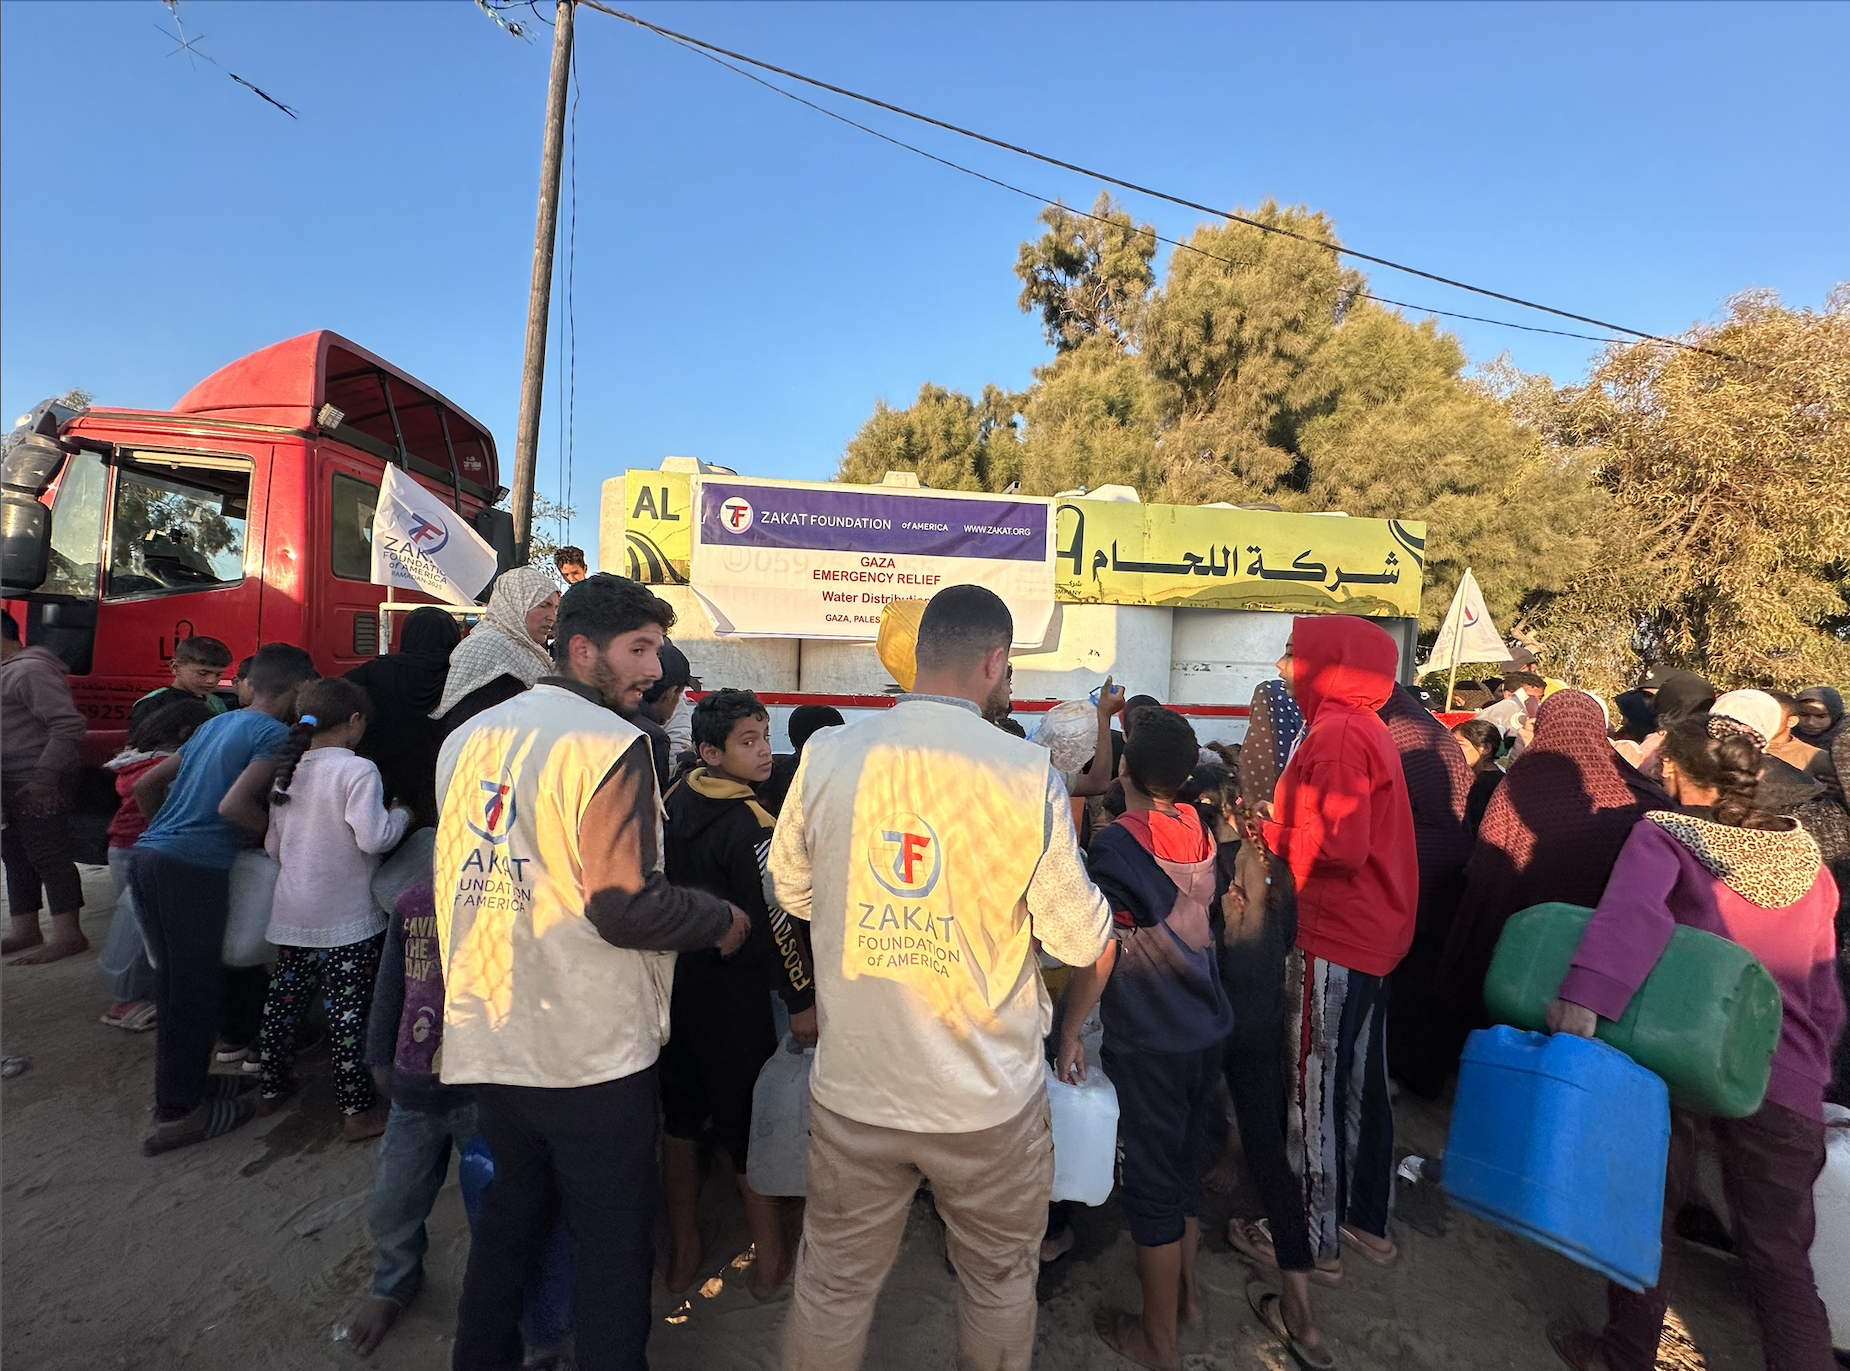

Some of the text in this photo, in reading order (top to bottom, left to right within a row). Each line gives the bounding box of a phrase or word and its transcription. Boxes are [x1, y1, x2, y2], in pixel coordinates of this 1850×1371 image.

[632, 486, 679, 521] AL
[760, 511, 808, 526] ZAKAT
[810, 515, 892, 530] FOUNDATION
[911, 522, 949, 532] AMERICA
[963, 524, 1031, 537] WWW.ZAKAT.ORG
[384, 535, 433, 563] ZAK
[860, 556, 896, 569] GAZA
[1092, 539, 1399, 592] شركة اللحام
[401, 564, 448, 585] AMERICA
[813, 569, 941, 585] EMERGENCY RELIEF
[822, 591, 931, 604] Water Distribti
[825, 614, 852, 623] GAZA,
[463, 894, 526, 913] AMERICA
[858, 903, 955, 943] ZAKAT
[858, 935, 960, 963] FOUNDATION
[405, 957, 432, 982] DAY
[867, 953, 950, 978] of AMERICA
